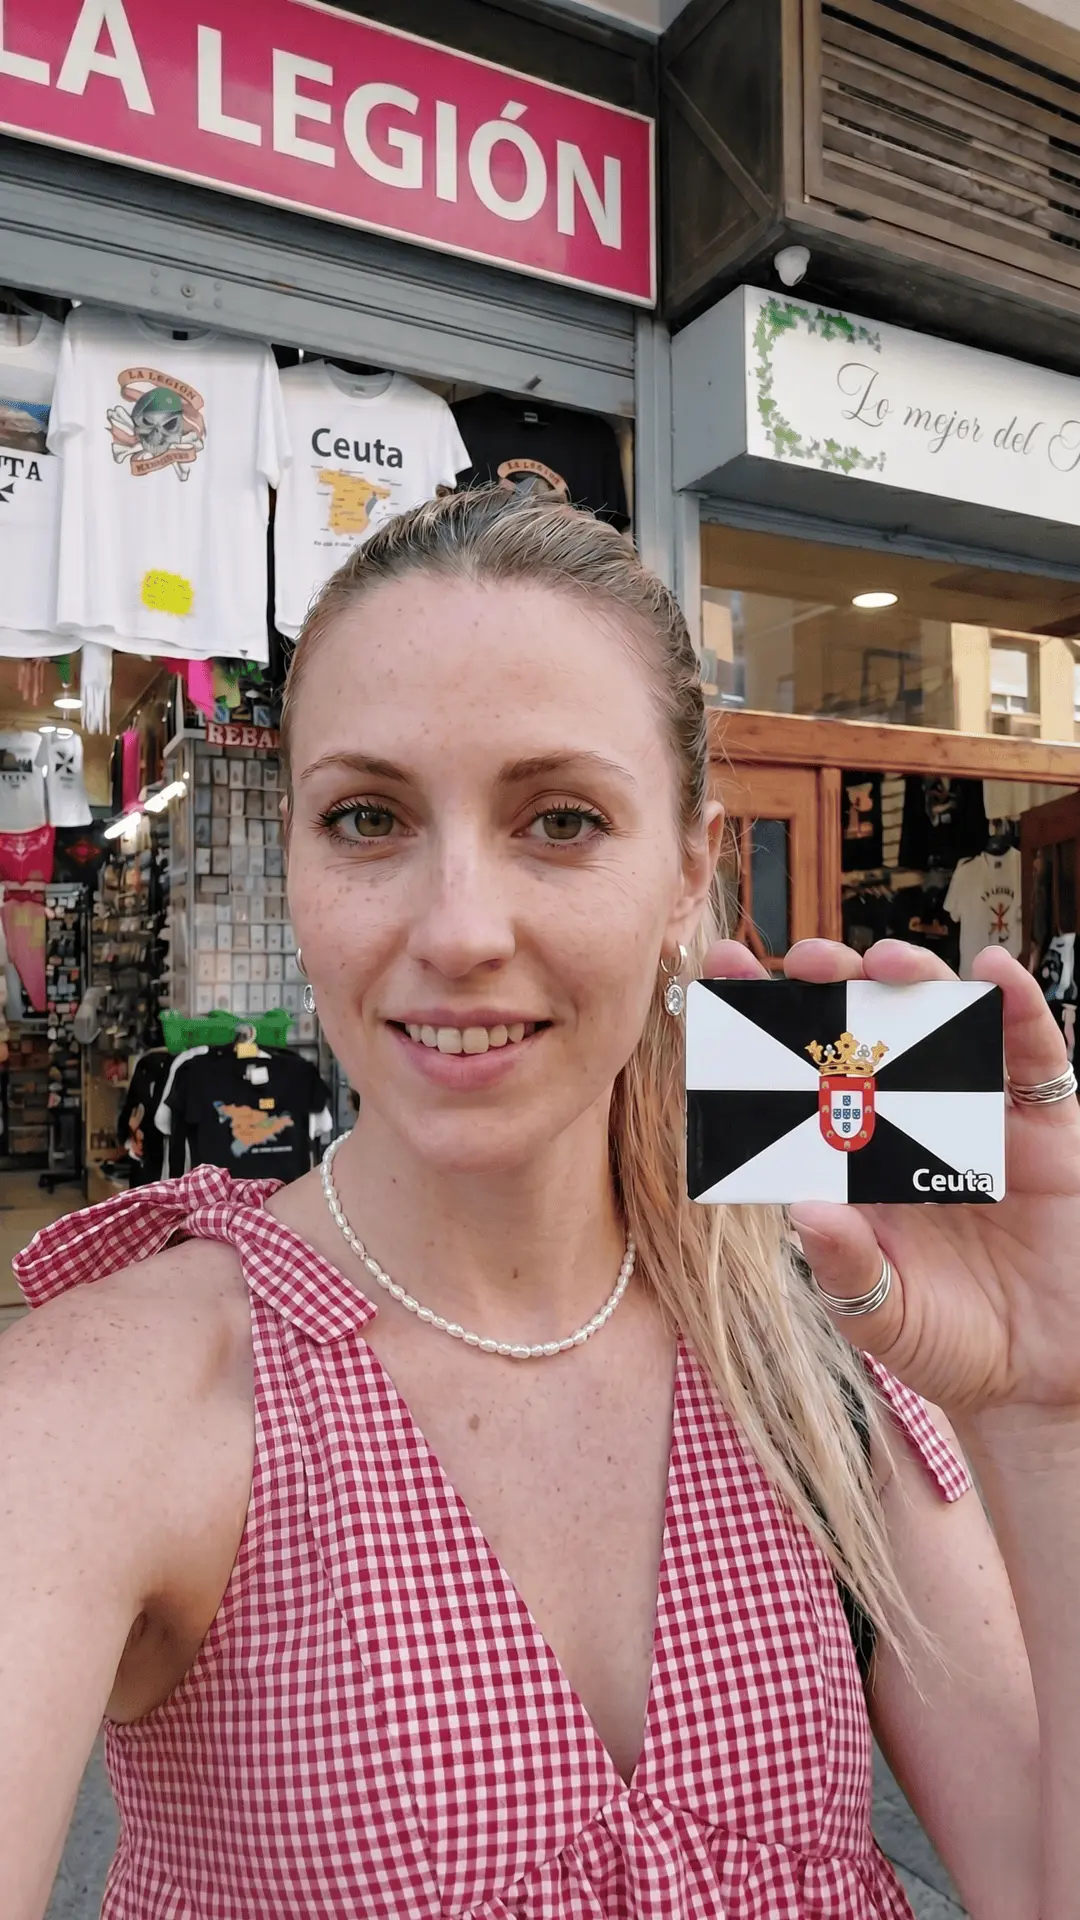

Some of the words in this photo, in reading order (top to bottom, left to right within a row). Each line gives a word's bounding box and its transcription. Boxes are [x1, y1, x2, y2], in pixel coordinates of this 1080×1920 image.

[198, 24, 622, 250] LEGIÓN
[128, 370, 145, 380] LA
[837, 362, 894, 428] Lo
[903, 406, 984, 454] mejor
[993, 416, 1046, 456] del
[311, 427, 404, 469] Ceuta
[0, 455, 44, 482] TA
[207, 721, 281, 749] REBA
[912, 1168, 994, 1193] Ceuta
